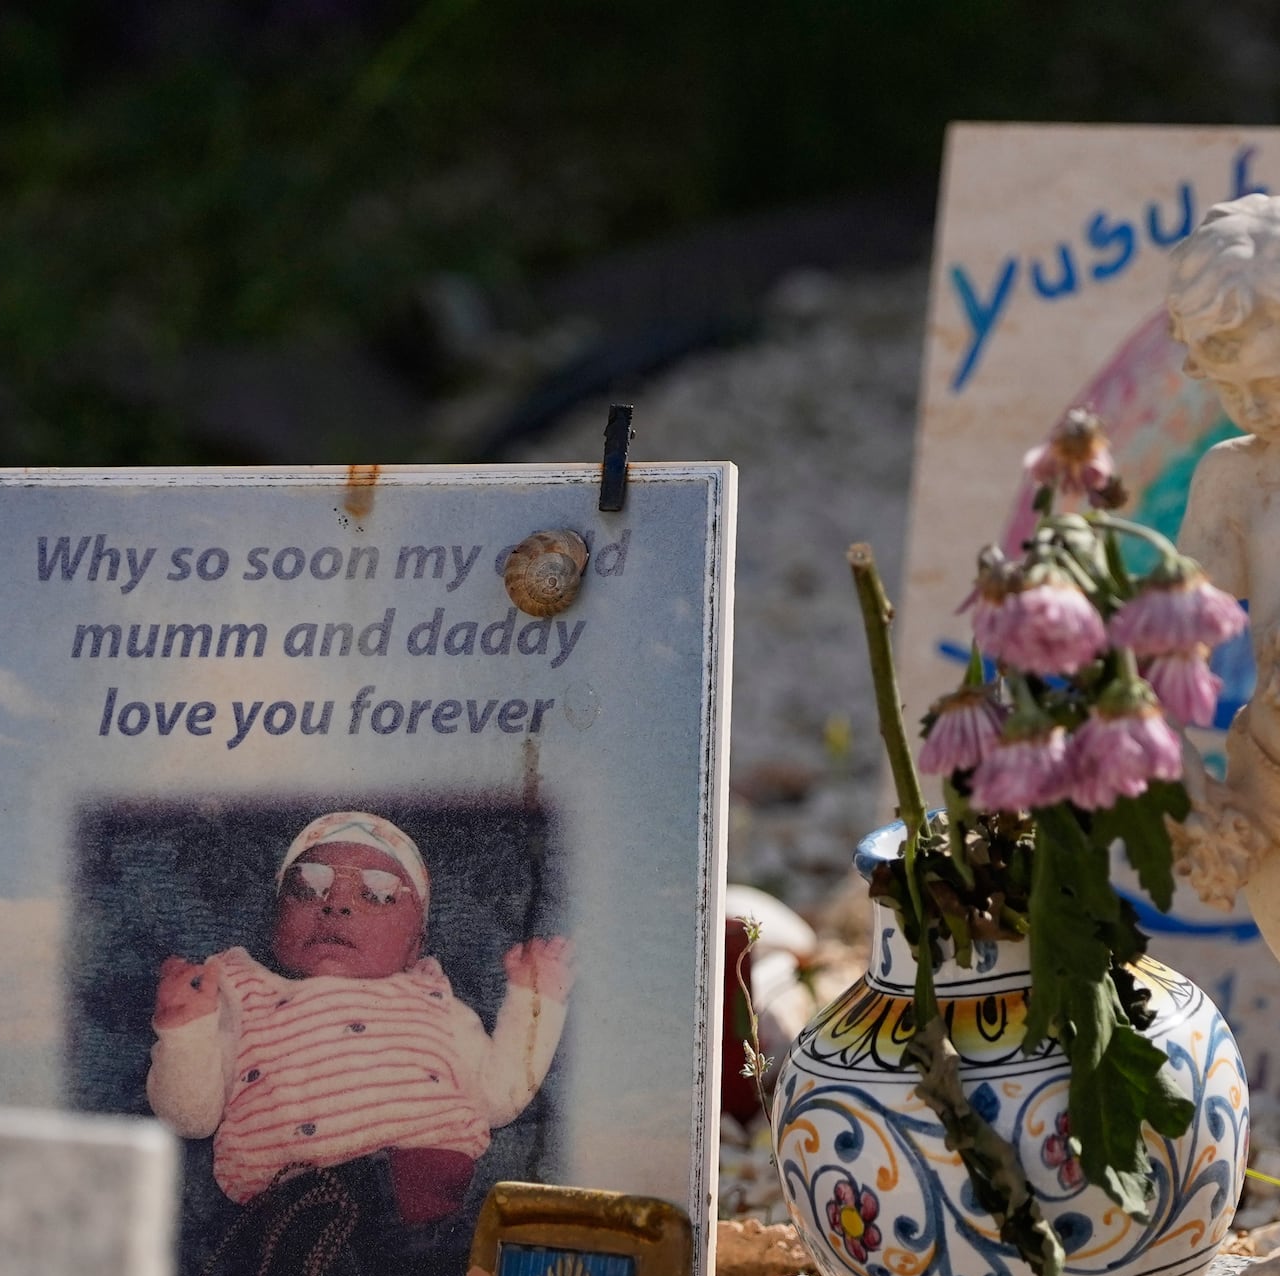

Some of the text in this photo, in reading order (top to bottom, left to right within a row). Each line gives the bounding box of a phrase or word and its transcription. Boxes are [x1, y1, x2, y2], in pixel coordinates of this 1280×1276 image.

[36, 533, 157, 594] Why
[167, 546, 230, 581] so
[242, 546, 380, 581] soon
[394, 545, 482, 592] my
[71, 607, 587, 669] mumm and daddy
[99, 685, 555, 750] love you forever
